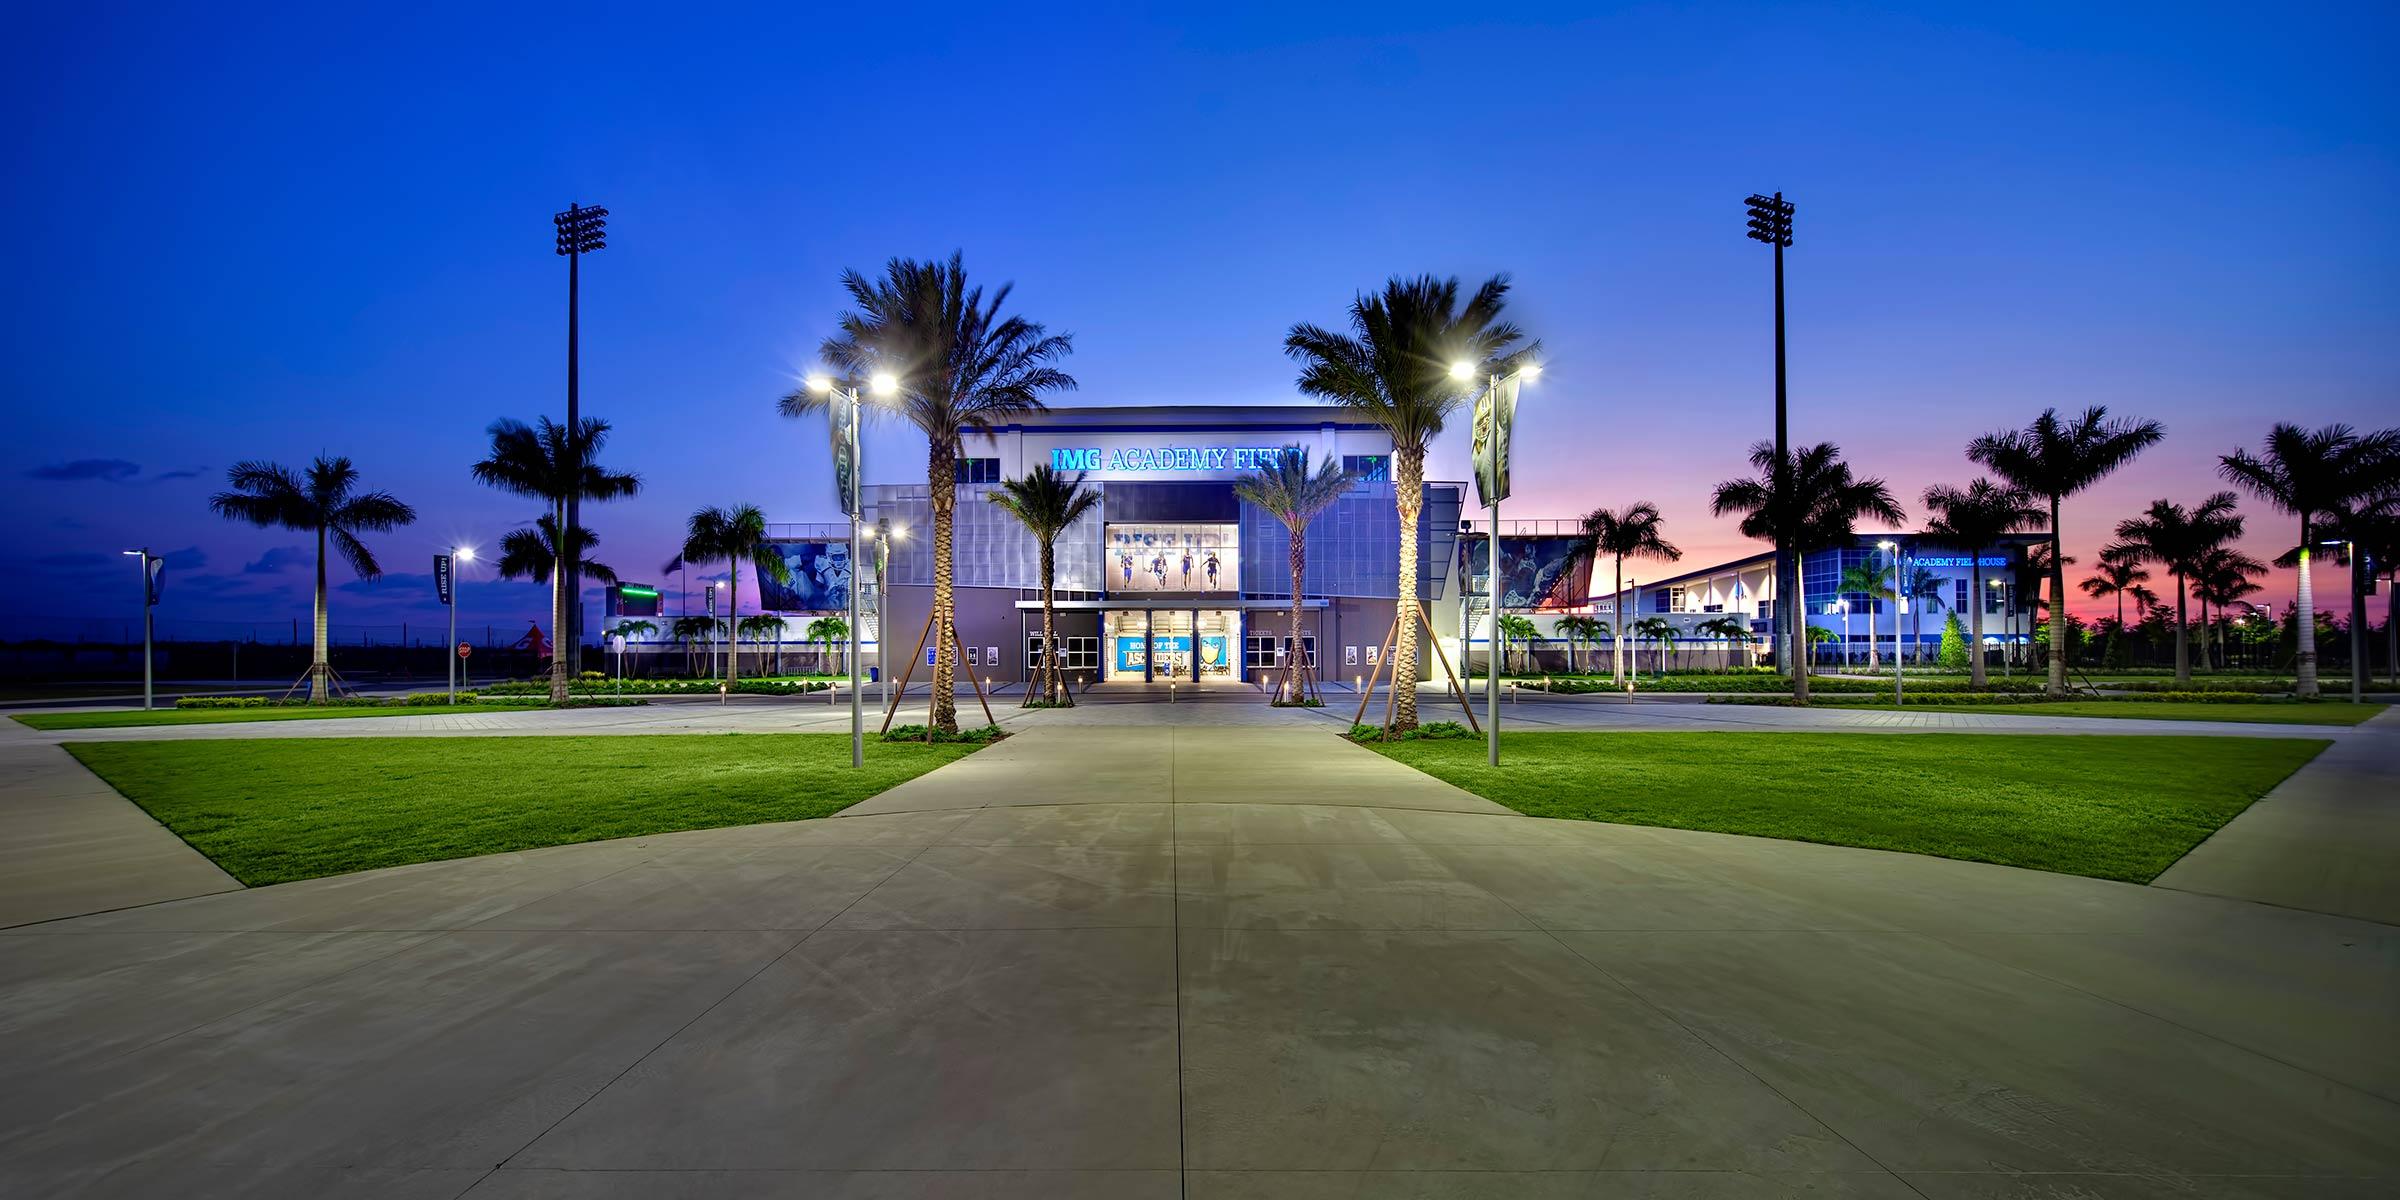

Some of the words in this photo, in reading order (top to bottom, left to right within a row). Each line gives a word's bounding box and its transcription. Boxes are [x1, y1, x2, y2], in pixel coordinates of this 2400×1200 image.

[1051, 449, 1100, 470] IMG
[1107, 449, 1227, 470] ACADEMY
[1913, 558, 1954, 567] ACADEMY
